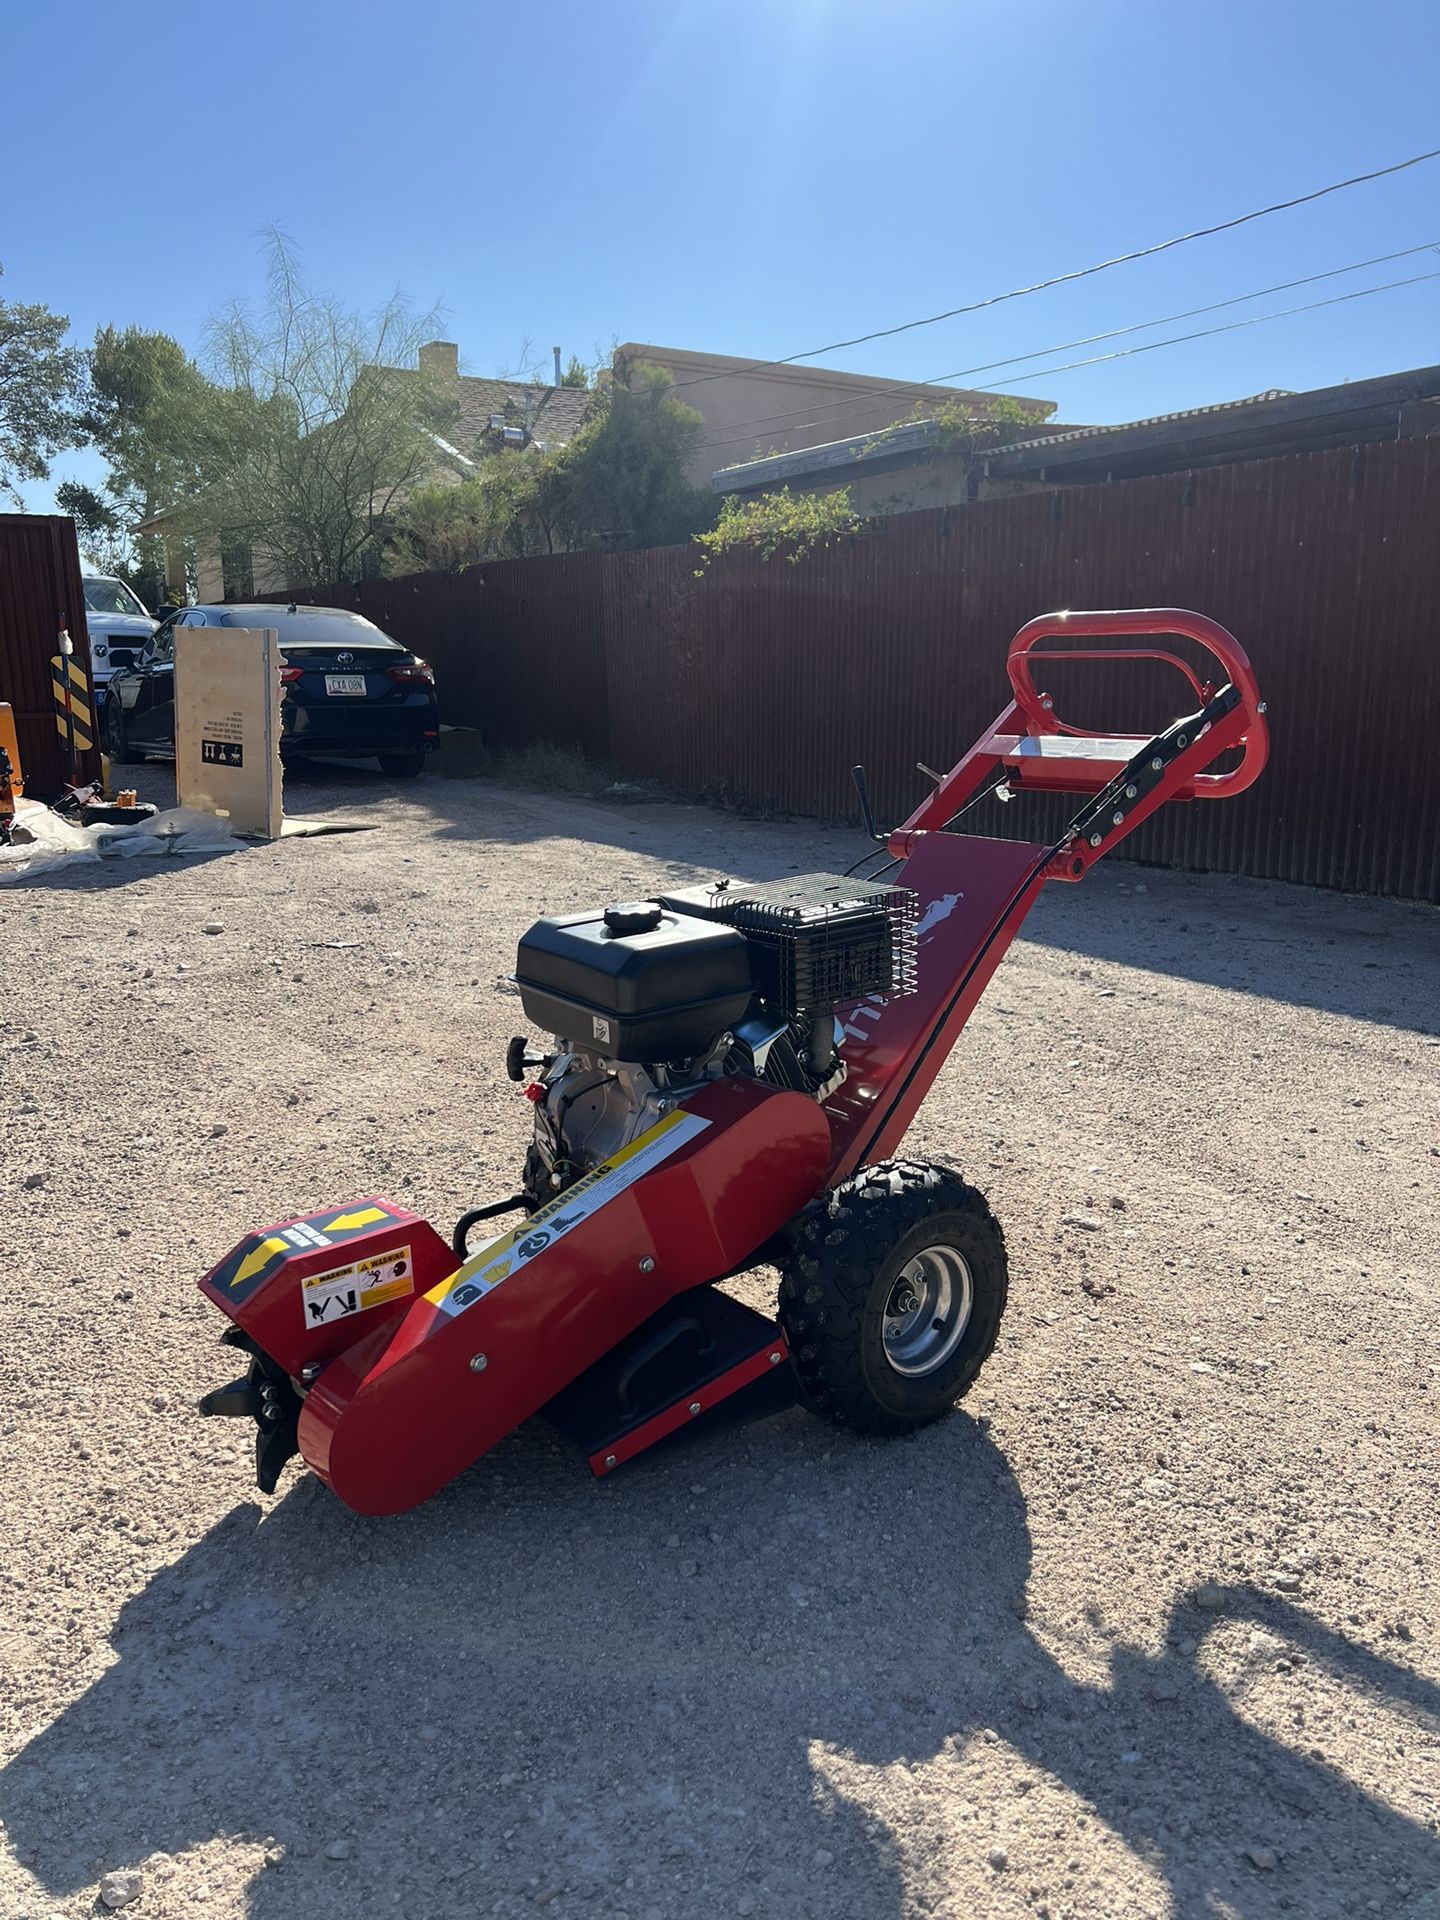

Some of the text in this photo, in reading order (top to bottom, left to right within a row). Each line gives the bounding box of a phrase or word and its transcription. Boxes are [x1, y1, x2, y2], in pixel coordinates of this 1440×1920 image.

[529, 1165, 615, 1225] WARNING
[370, 1251, 405, 1268] WARNING
[319, 1267, 353, 1283] WARNING
